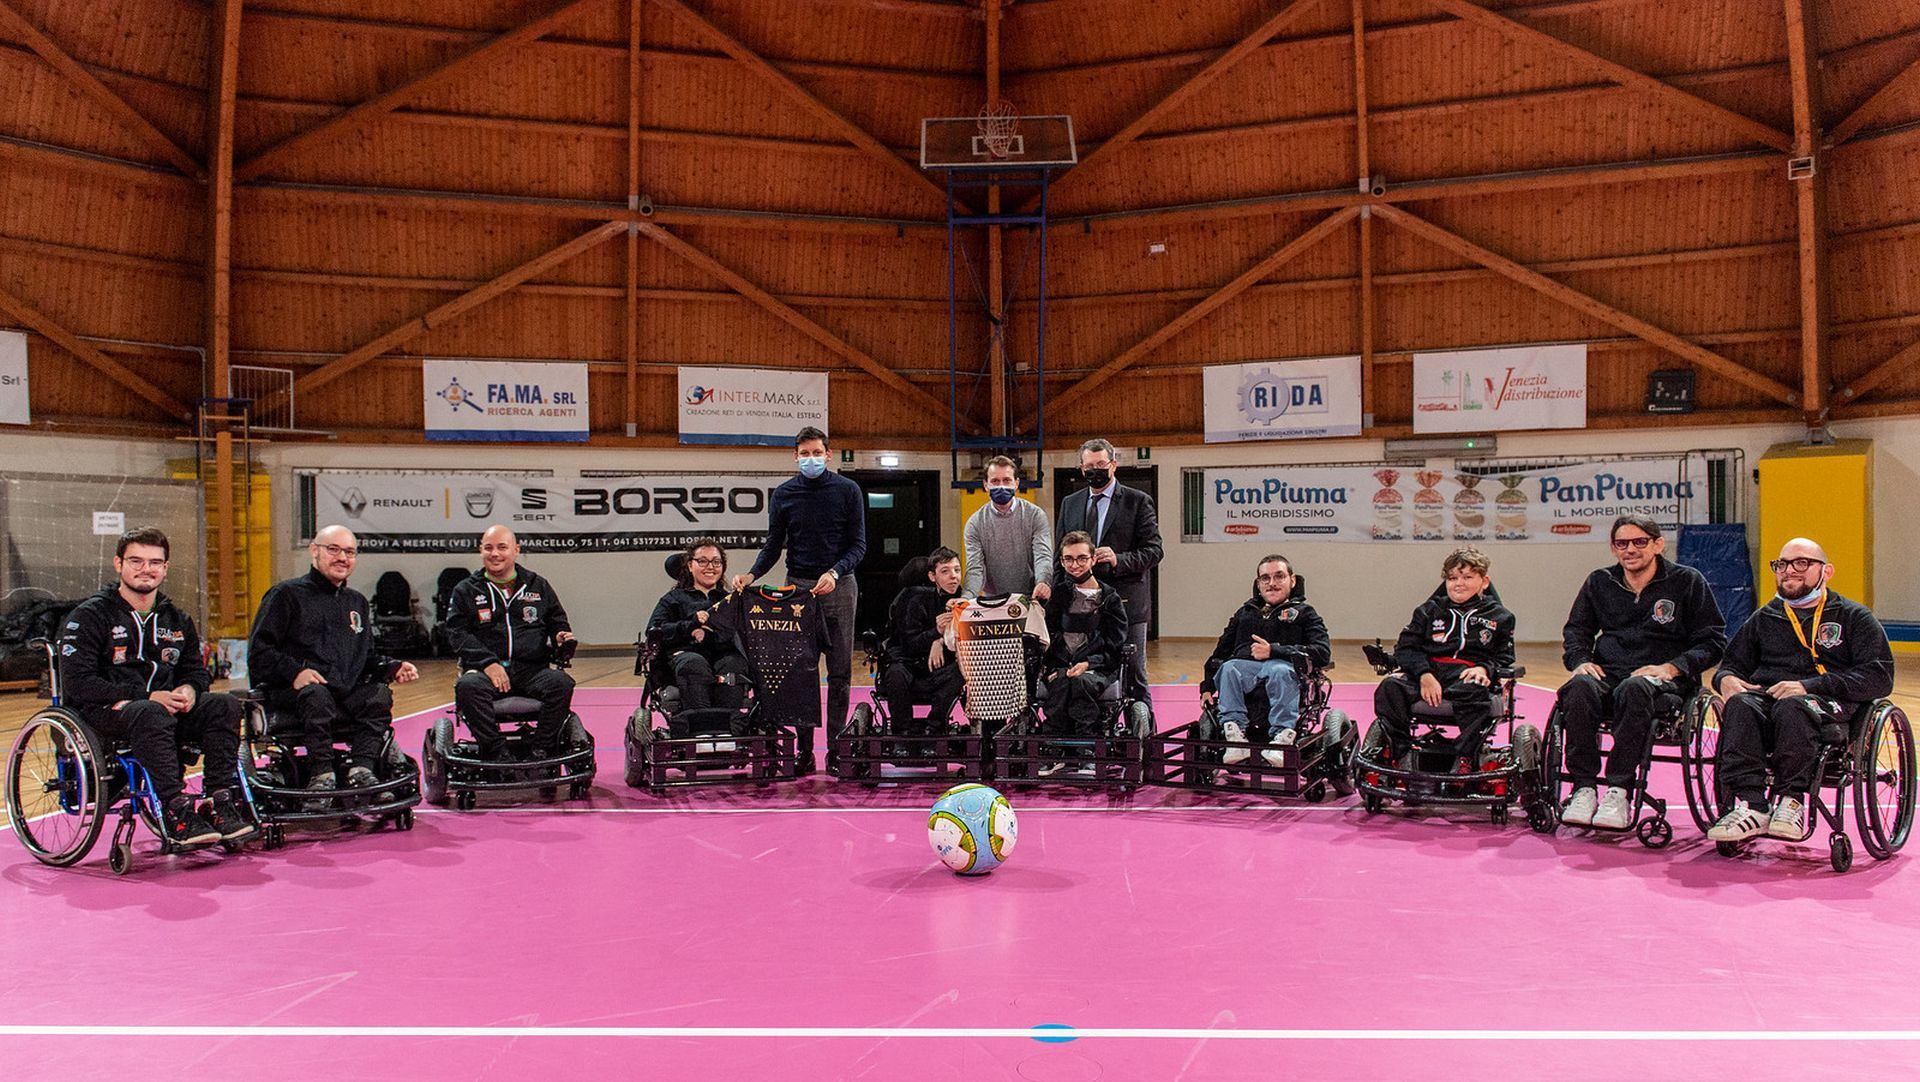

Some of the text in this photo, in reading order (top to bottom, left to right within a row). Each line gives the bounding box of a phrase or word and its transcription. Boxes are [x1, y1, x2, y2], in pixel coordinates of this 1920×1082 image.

[1, 375, 20, 385] Srl
[553, 392, 577, 405] SRL
[1503, 387, 1583, 401] distribuzione
[487, 407, 577, 417] RICERCA AGENTI
[686, 408, 721, 416] CREAZIONE
[722, 409, 735, 417] RETI
[745, 410, 770, 418] VENDITA
[797, 412, 822, 420] ESTERO
[1214, 478, 1348, 504] PanPiuma
[1539, 473, 1694, 503] PanPiuma
[373, 498, 433, 508] RENAULT
[1226, 508, 1335, 519] IL MORBIDISSIMO
[1554, 503, 1680, 518] IL MORBIDISSIMO
[391, 539, 401, 548] A
[403, 539, 446, 548] MESTRE
[448, 539, 471, 548] (VE)
[580, 538, 593, 547] 75
[601, 537, 611, 547] T.
[613, 537, 630, 546] 041
[632, 536, 671, 546] 5317733
[749, 619, 802, 632] VENEZIA
[969, 623, 1023, 636] VENEZIA
